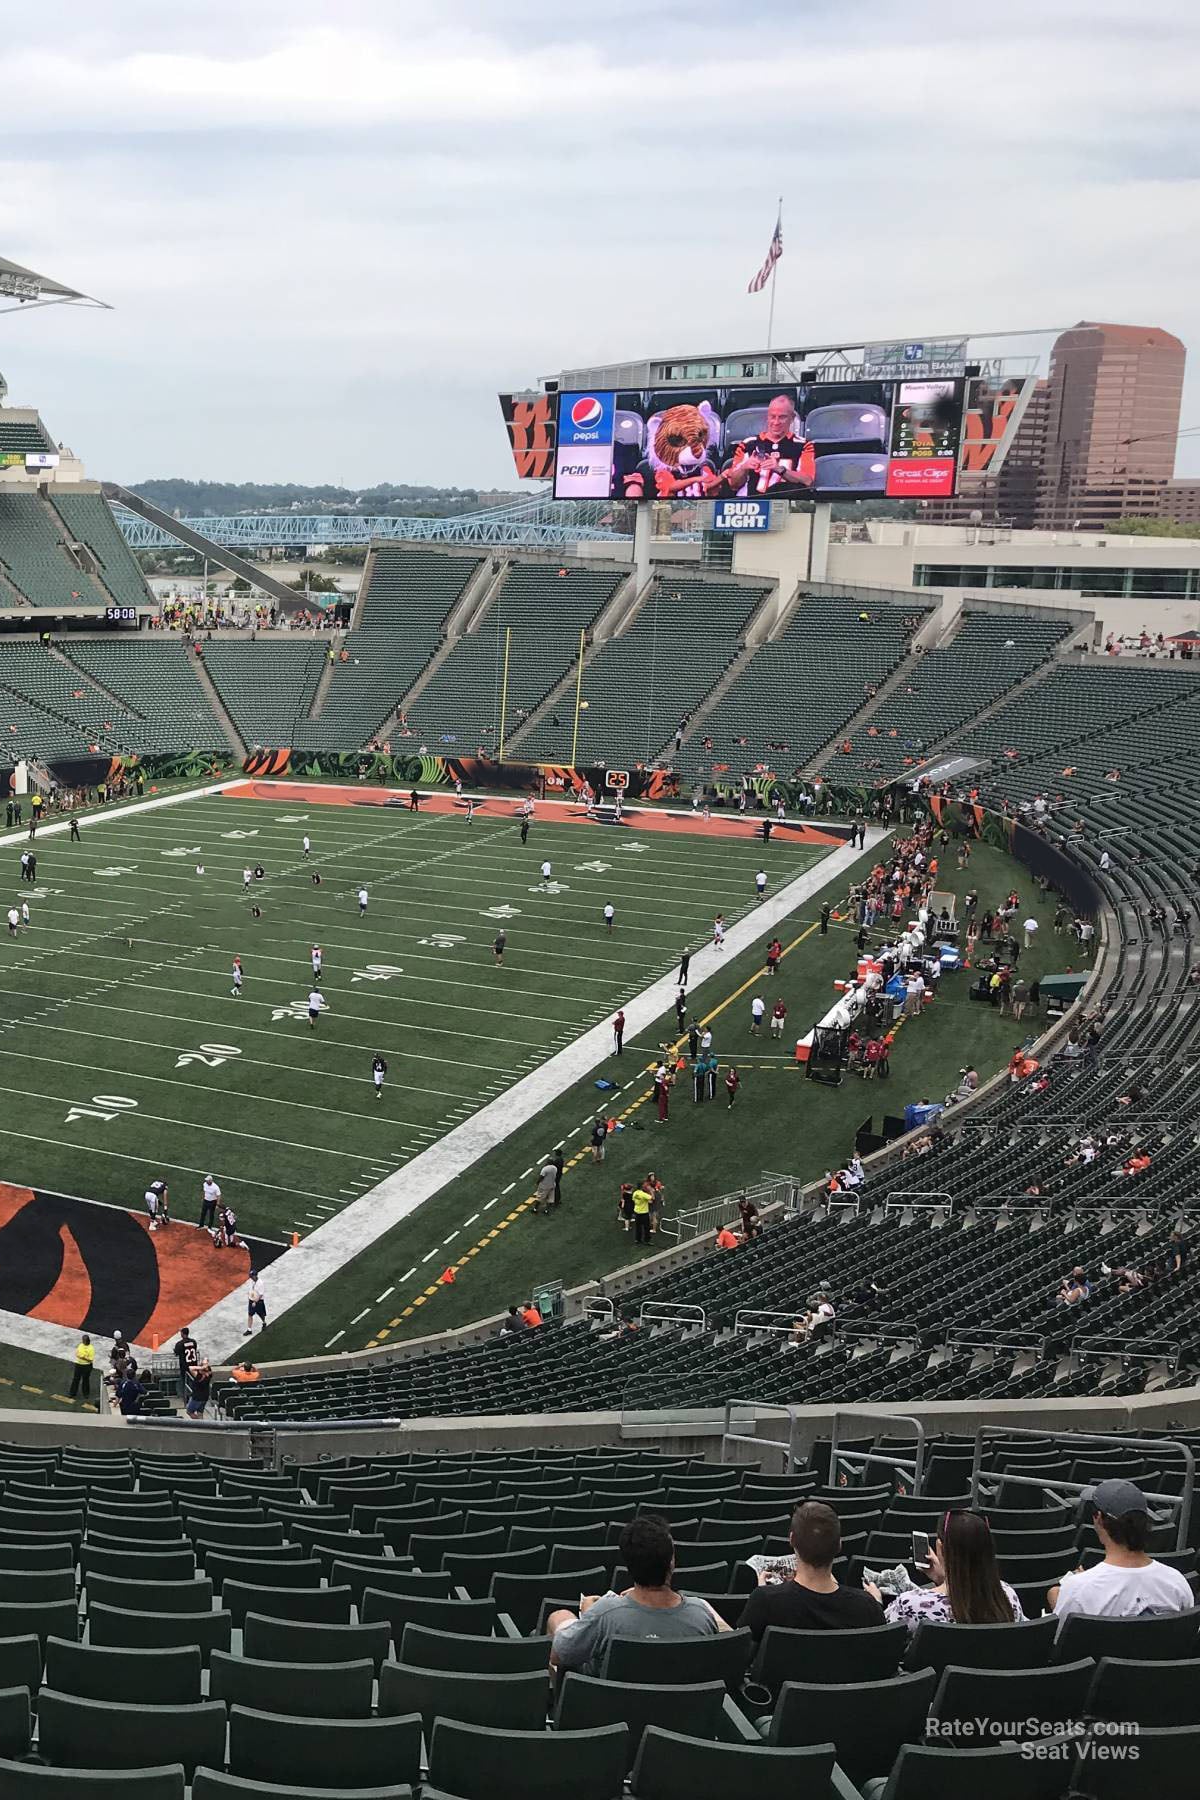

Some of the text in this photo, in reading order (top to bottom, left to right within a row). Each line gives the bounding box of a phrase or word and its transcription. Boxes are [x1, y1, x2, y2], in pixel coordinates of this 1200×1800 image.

[897, 363, 928, 371] THIRD
[931, 362, 961, 370] BANK
[573, 431, 599, 442] pepsi
[560, 465, 589, 475] PCM
[893, 468, 949, 479] Great Clips
[723, 502, 760, 515] BUD
[716, 515, 767, 528] LIGHT
[610, 773, 626, 786] 25
[17, 887, 65, 898] 50
[478, 906, 522, 919] 40
[417, 933, 467, 948] 50
[352, 964, 404, 980] 40
[271, 1001, 330, 1020] 30
[178, 1044, 242, 1067] 20
[68, 1095, 138, 1121] 10
[184, 1348, 197, 1363] 23
